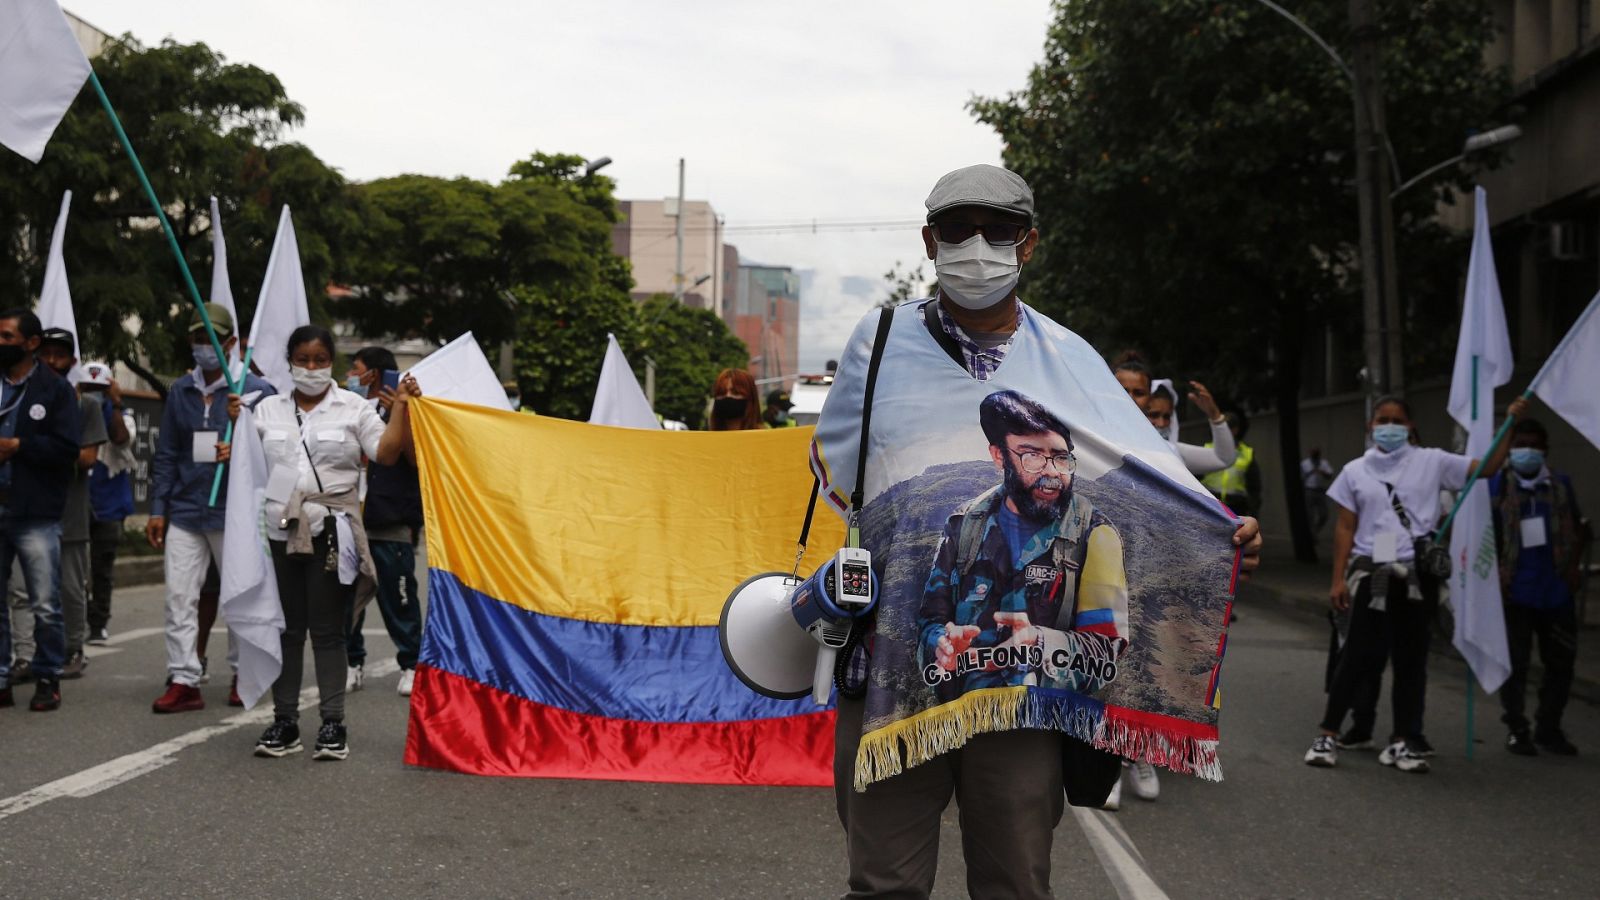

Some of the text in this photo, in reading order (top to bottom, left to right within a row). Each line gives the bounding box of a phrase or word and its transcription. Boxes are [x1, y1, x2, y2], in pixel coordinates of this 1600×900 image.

[1028, 567, 1057, 579] FARC-E
[924, 645, 1117, 686] C. ALFONSO CANO
